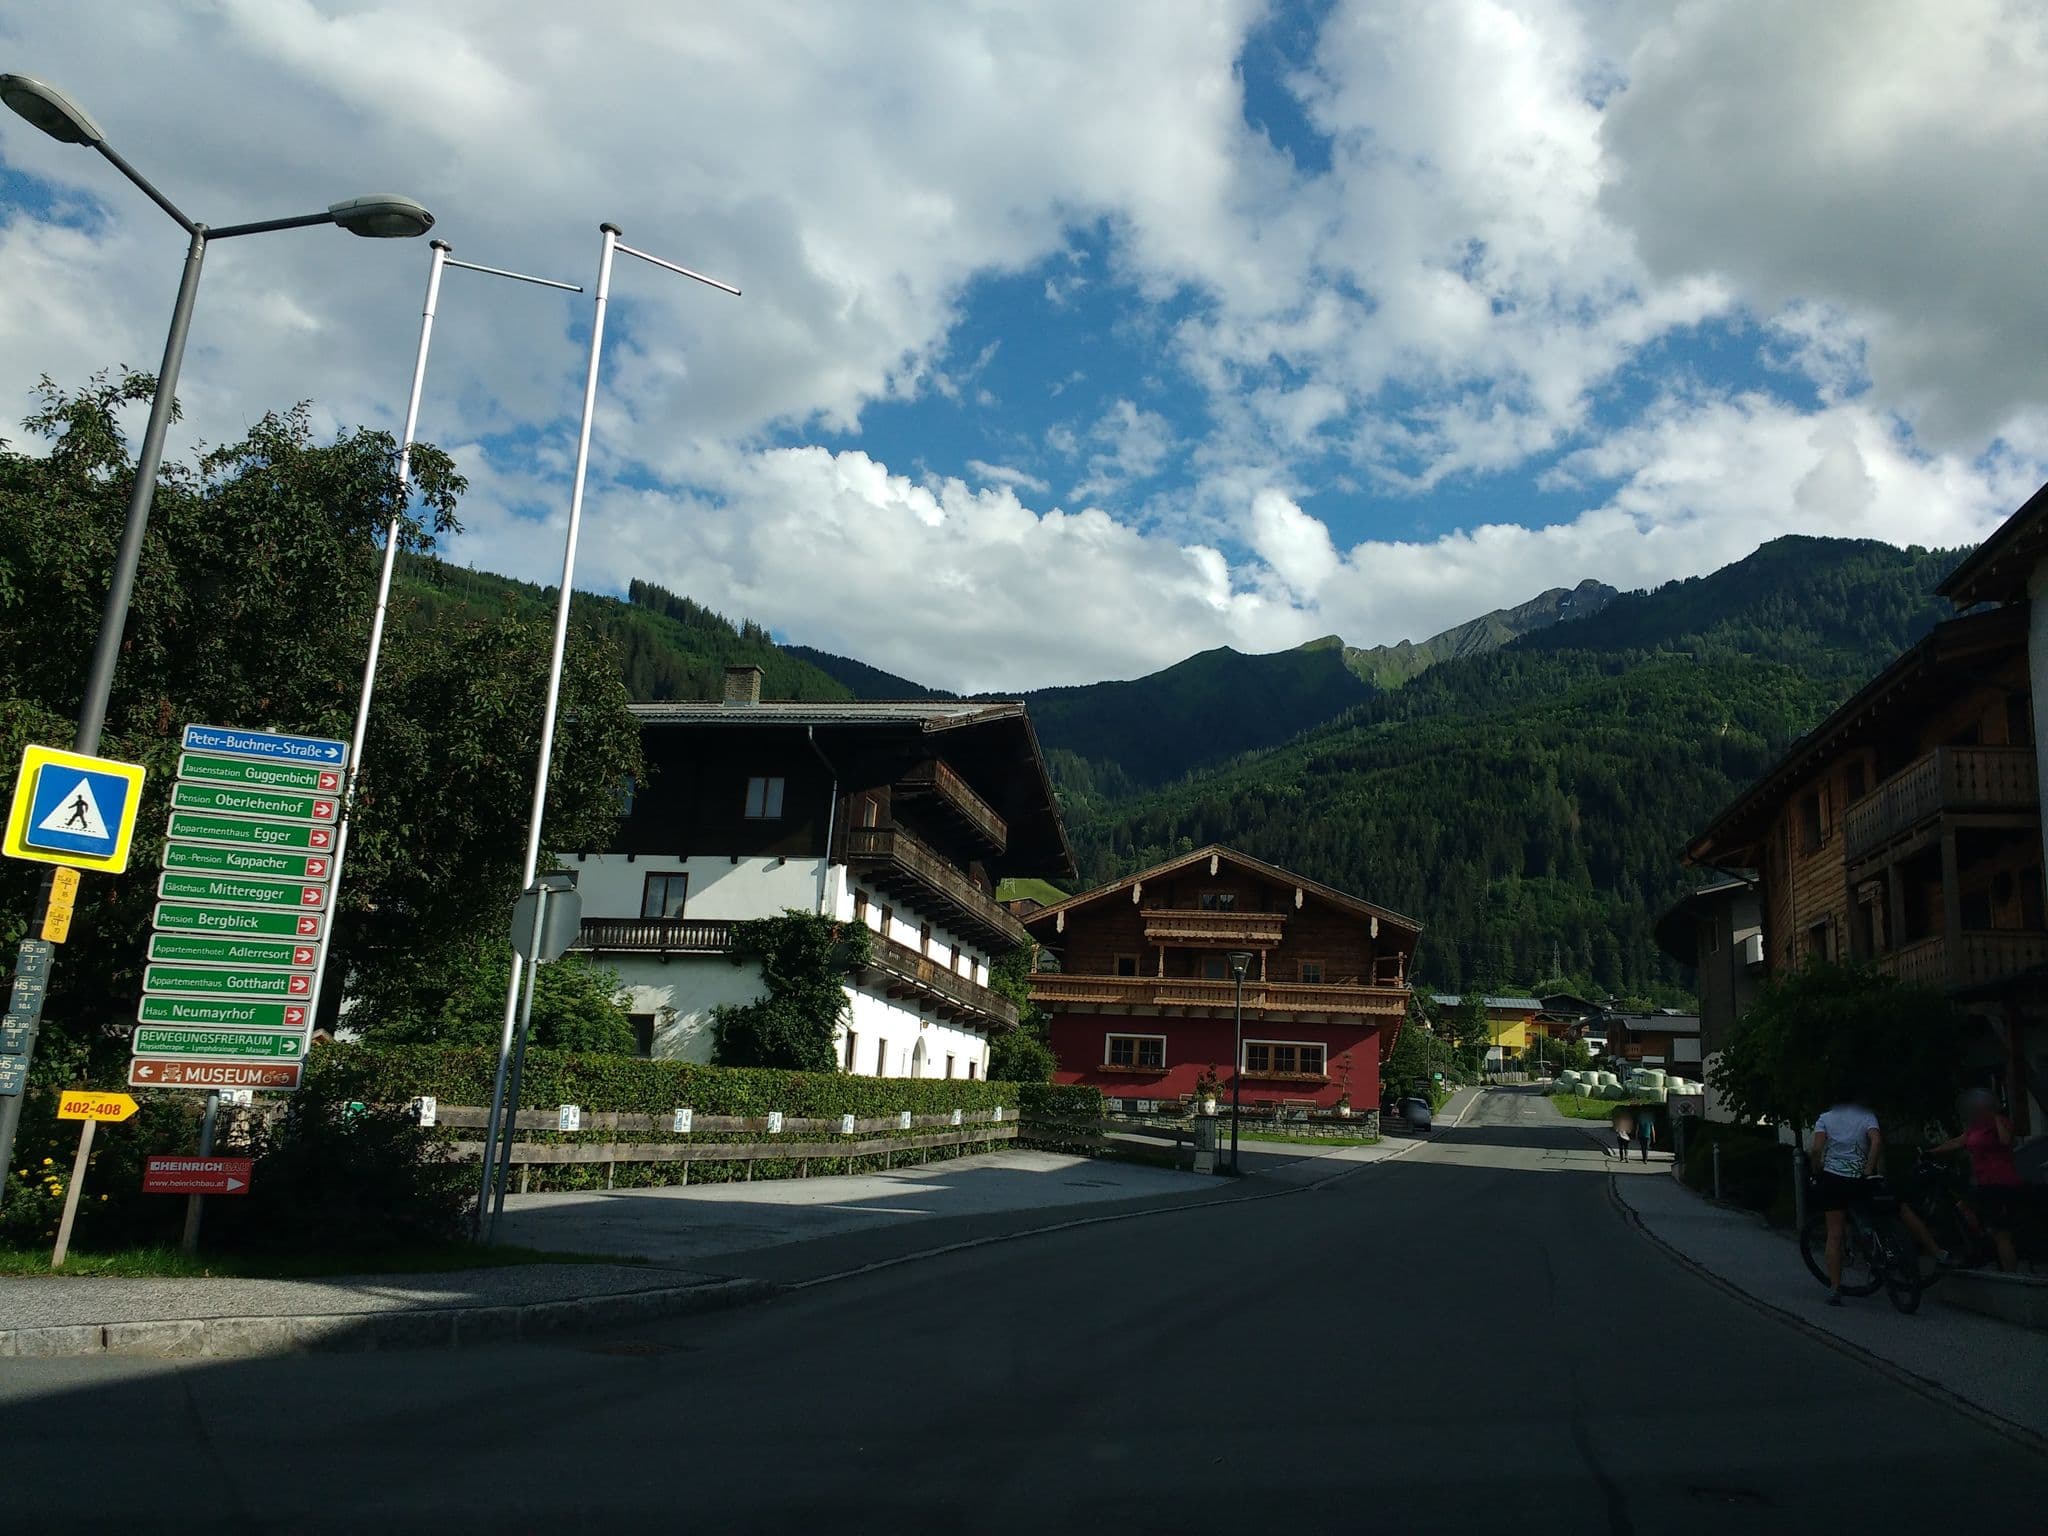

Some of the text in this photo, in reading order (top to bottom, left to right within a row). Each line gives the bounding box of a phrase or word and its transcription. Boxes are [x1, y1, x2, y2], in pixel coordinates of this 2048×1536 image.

[188, 731, 322, 758] Peter-Buchner-Straße
[184, 763, 317, 785] Jausenstation Guggenbichl
[178, 792, 304, 813] Pension Oberlehenhof
[174, 823, 291, 842] Appartementhaus Egger
[169, 851, 288, 869] App.-Pension Kappacher
[165, 882, 284, 901] Gästehaus Mitteregger
[160, 912, 259, 929] Pension Bergblick
[155, 944, 290, 961] Appartementhotel Adlerresort
[150, 975, 286, 991] Appartementhaus Gotthardt
[145, 1004, 256, 1021] Haus Neumayrhof
[2, 1019, 17, 1028] HS
[140, 1031, 273, 1046] BEWEGUNGSFREIRAUM
[185, 1066, 263, 1084] MUSEUM
[63, 1101, 122, 1116] 402-408
[149, 1179, 224, 1188] www.heinrichbau.at
